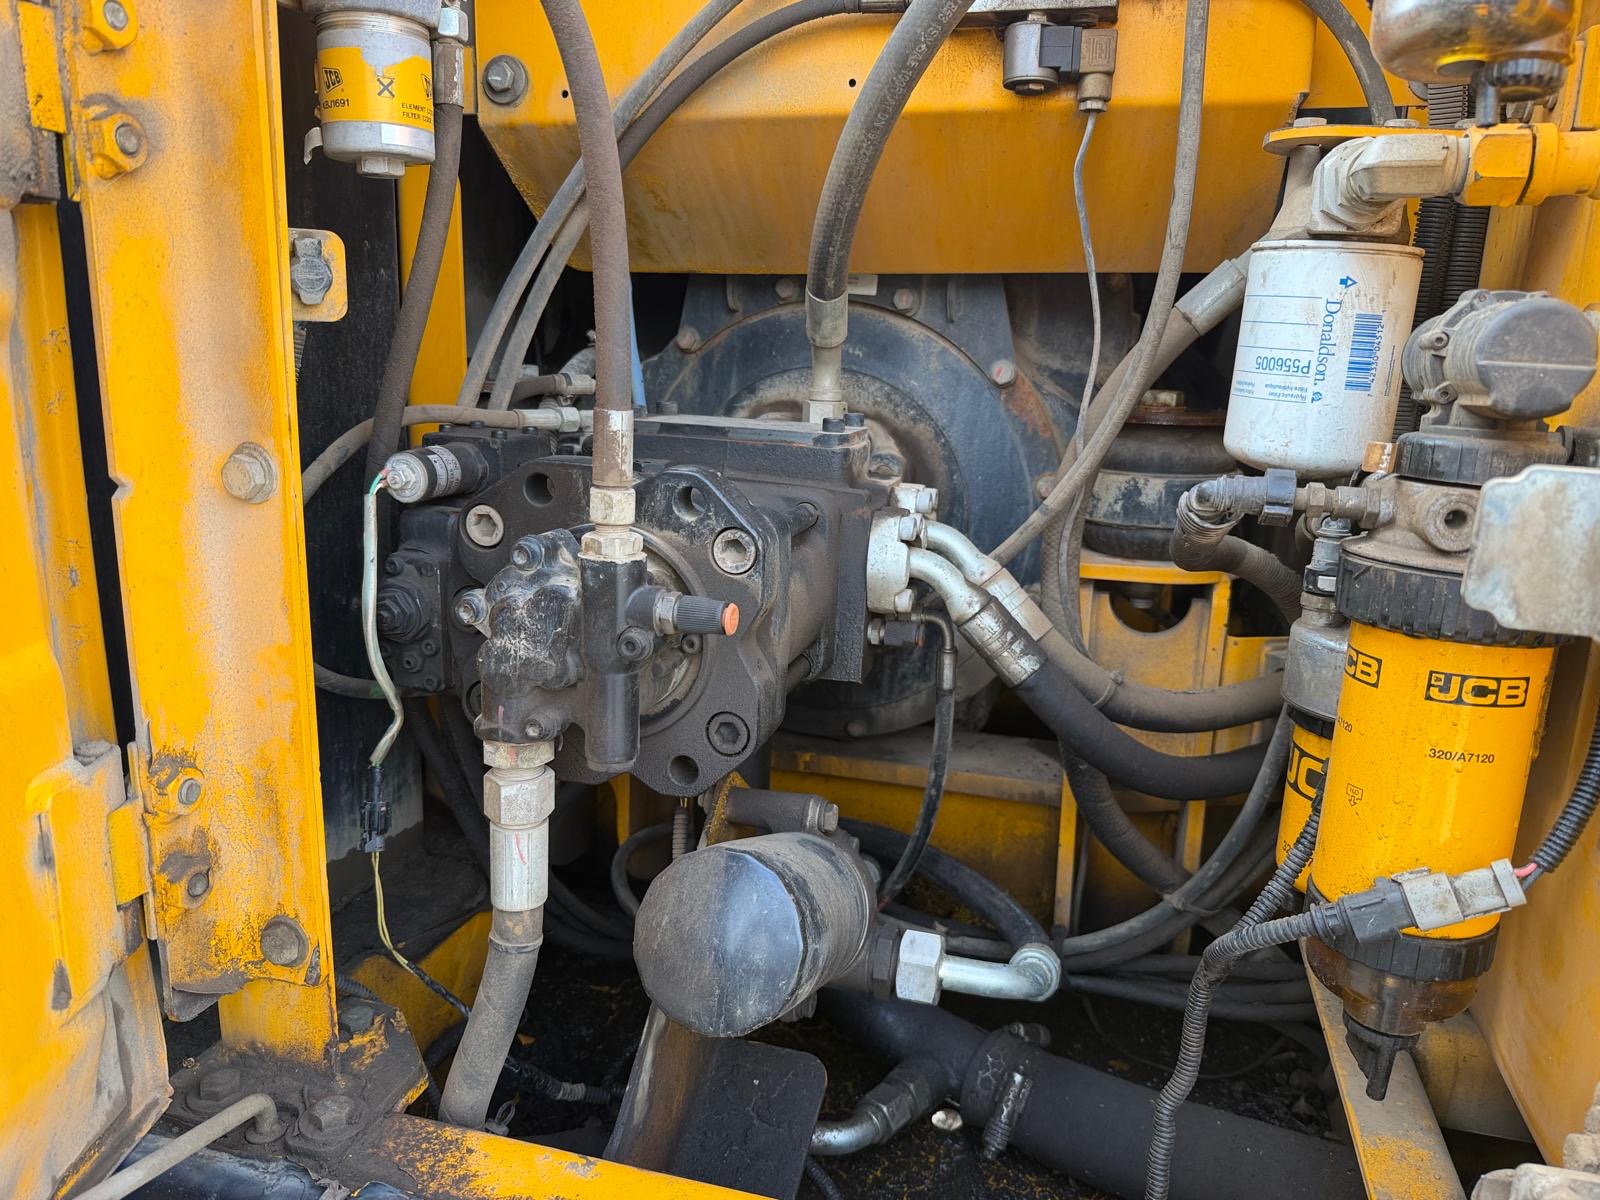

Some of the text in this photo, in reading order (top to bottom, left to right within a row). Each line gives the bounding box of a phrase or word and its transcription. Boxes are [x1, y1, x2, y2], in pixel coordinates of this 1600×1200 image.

[323, 68, 342, 92] JCB
[402, 111, 421, 121] FILTER
[1255, 355, 1312, 375] P556005
[1345, 646, 1380, 687] CB
[1426, 671, 1529, 707] JCB
[1428, 747, 1495, 764] 320/A7120
[1287, 749, 1325, 802] JC
